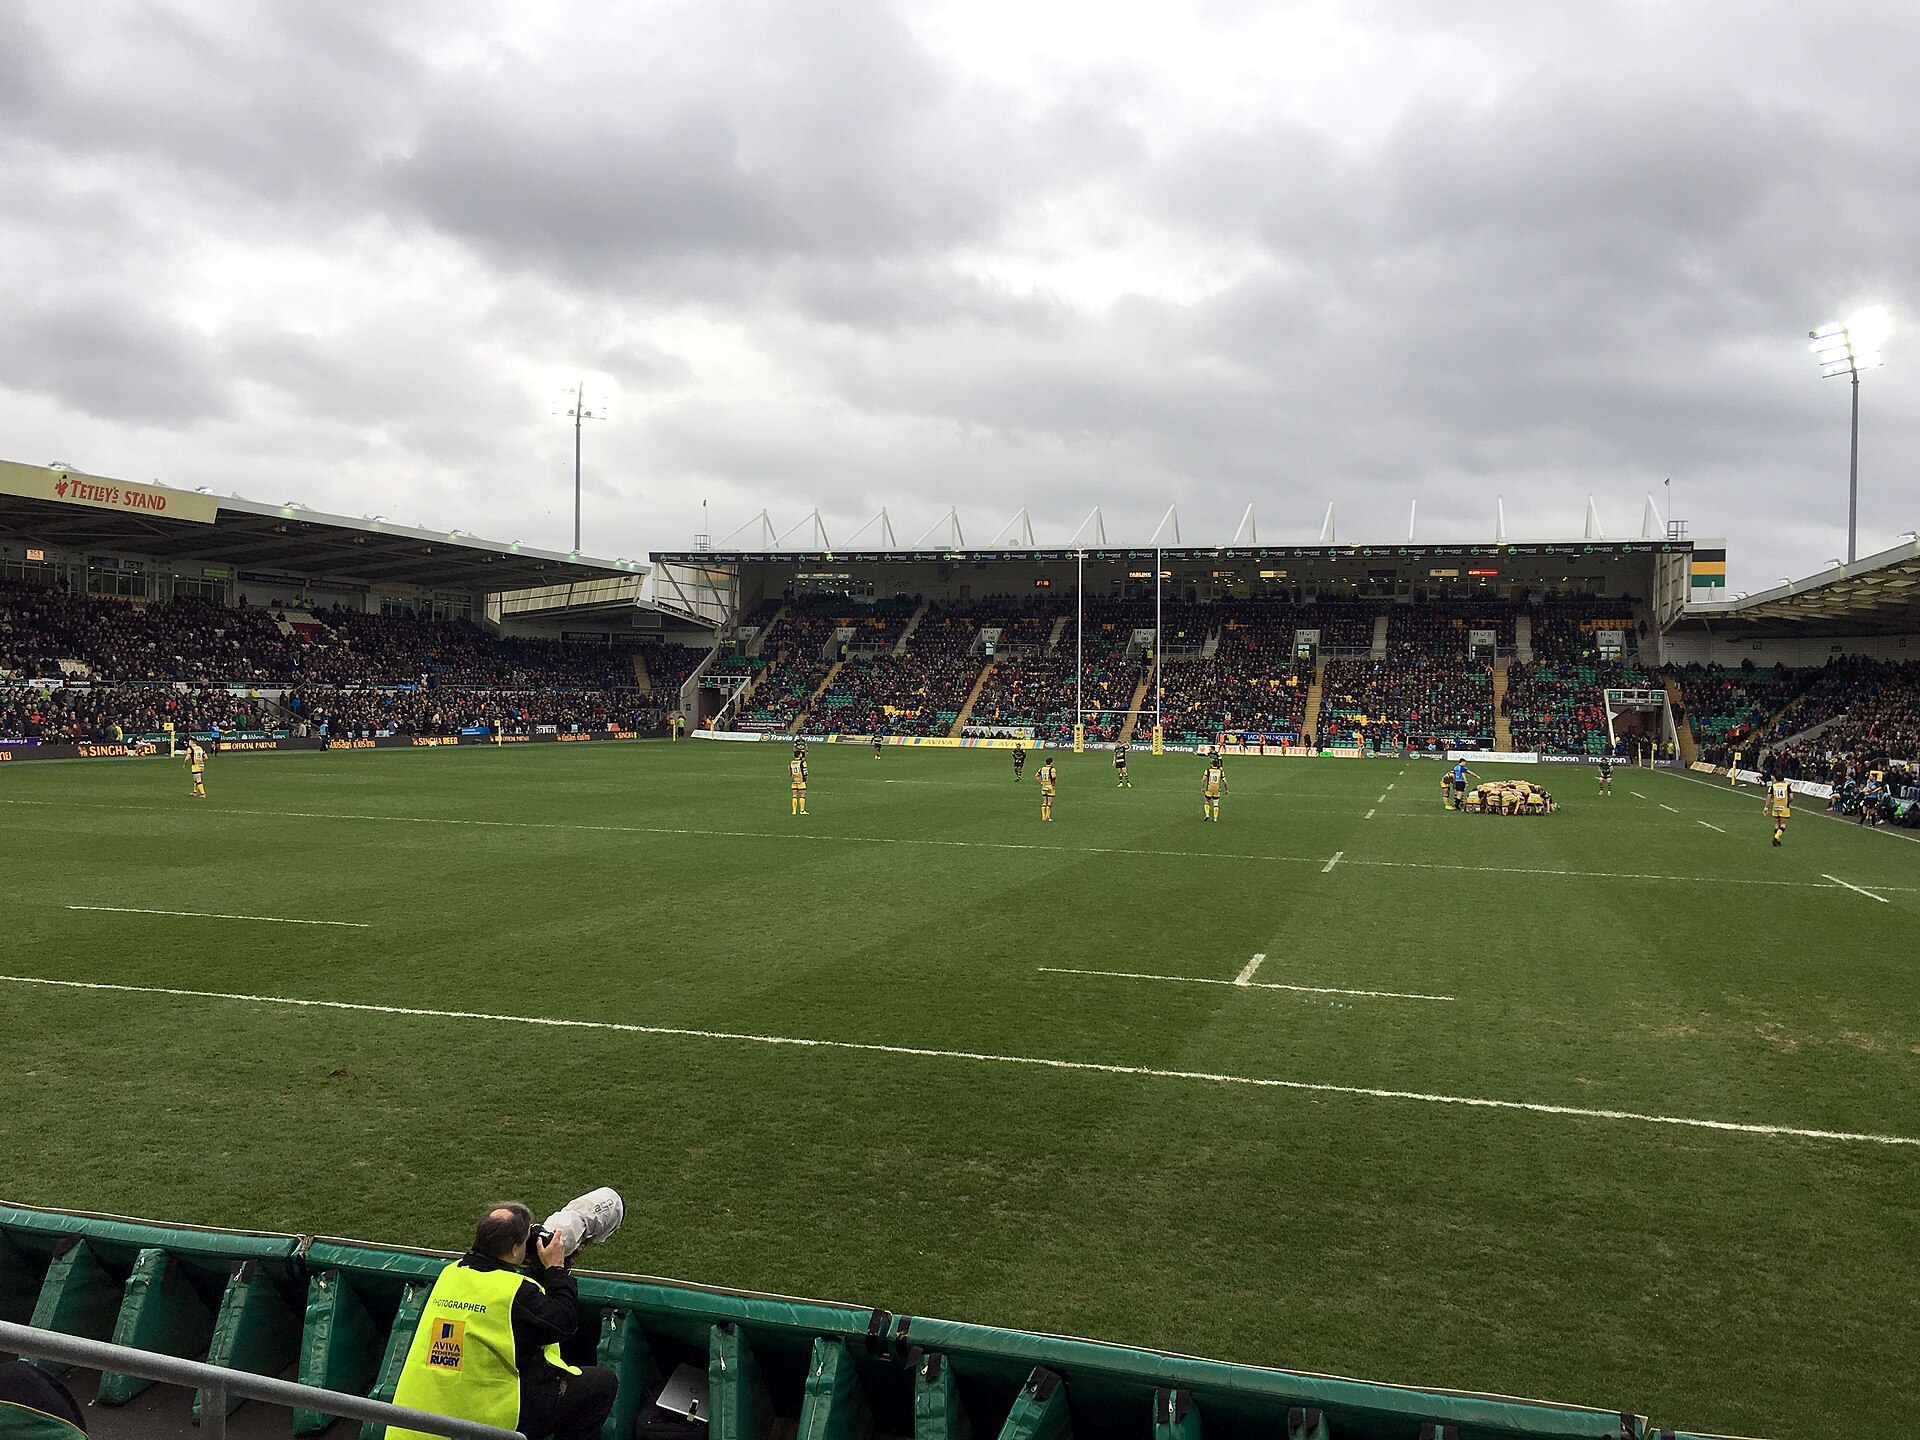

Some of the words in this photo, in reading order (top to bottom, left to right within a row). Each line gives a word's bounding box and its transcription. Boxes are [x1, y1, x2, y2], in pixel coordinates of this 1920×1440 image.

[124, 491, 166, 510] STAND
[90, 745, 128, 757] SINGHA
[432, 1299, 486, 1313] PHOTOGRAPHER
[433, 1342, 460, 1352] AVIVA
[430, 1355, 460, 1367] RUGBY
